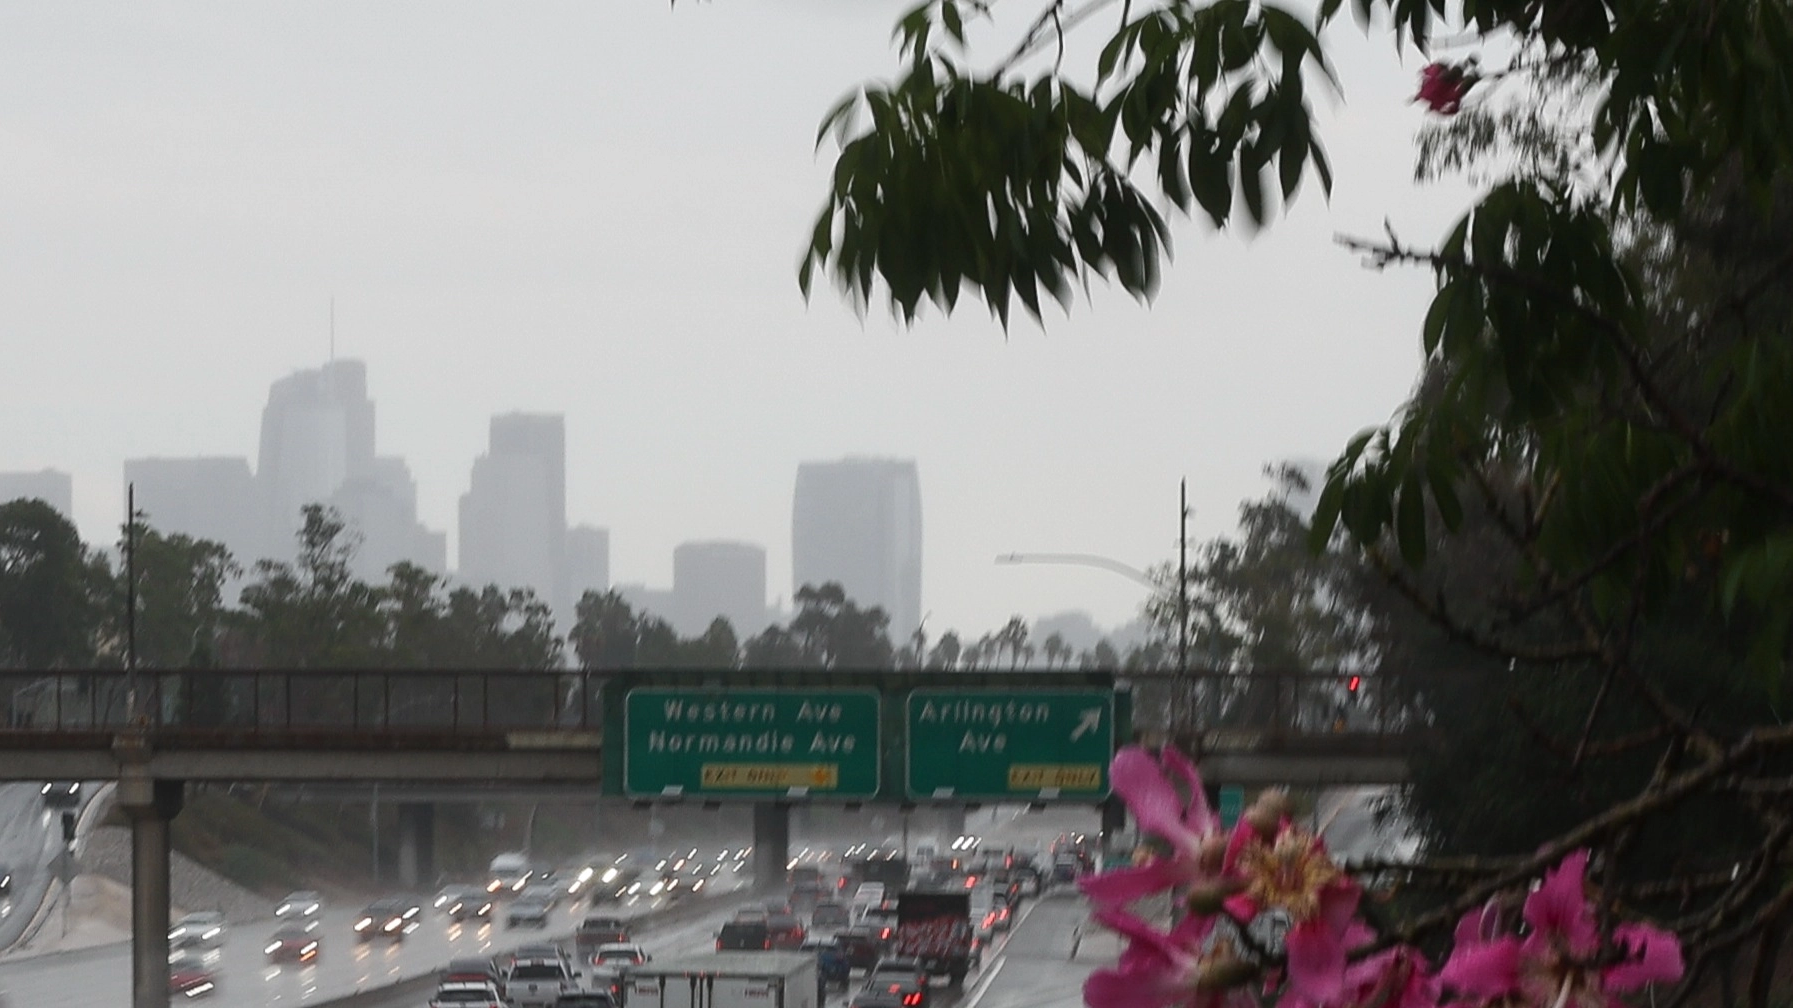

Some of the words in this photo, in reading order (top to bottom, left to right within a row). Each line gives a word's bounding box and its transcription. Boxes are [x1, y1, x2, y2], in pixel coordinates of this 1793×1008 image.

[664, 699, 775, 722] Western
[796, 699, 842, 722] Ave
[919, 699, 1049, 728] Arlington
[649, 730, 795, 753] Normandie
[809, 730, 855, 753] Ave
[959, 729, 1007, 753] Ave
